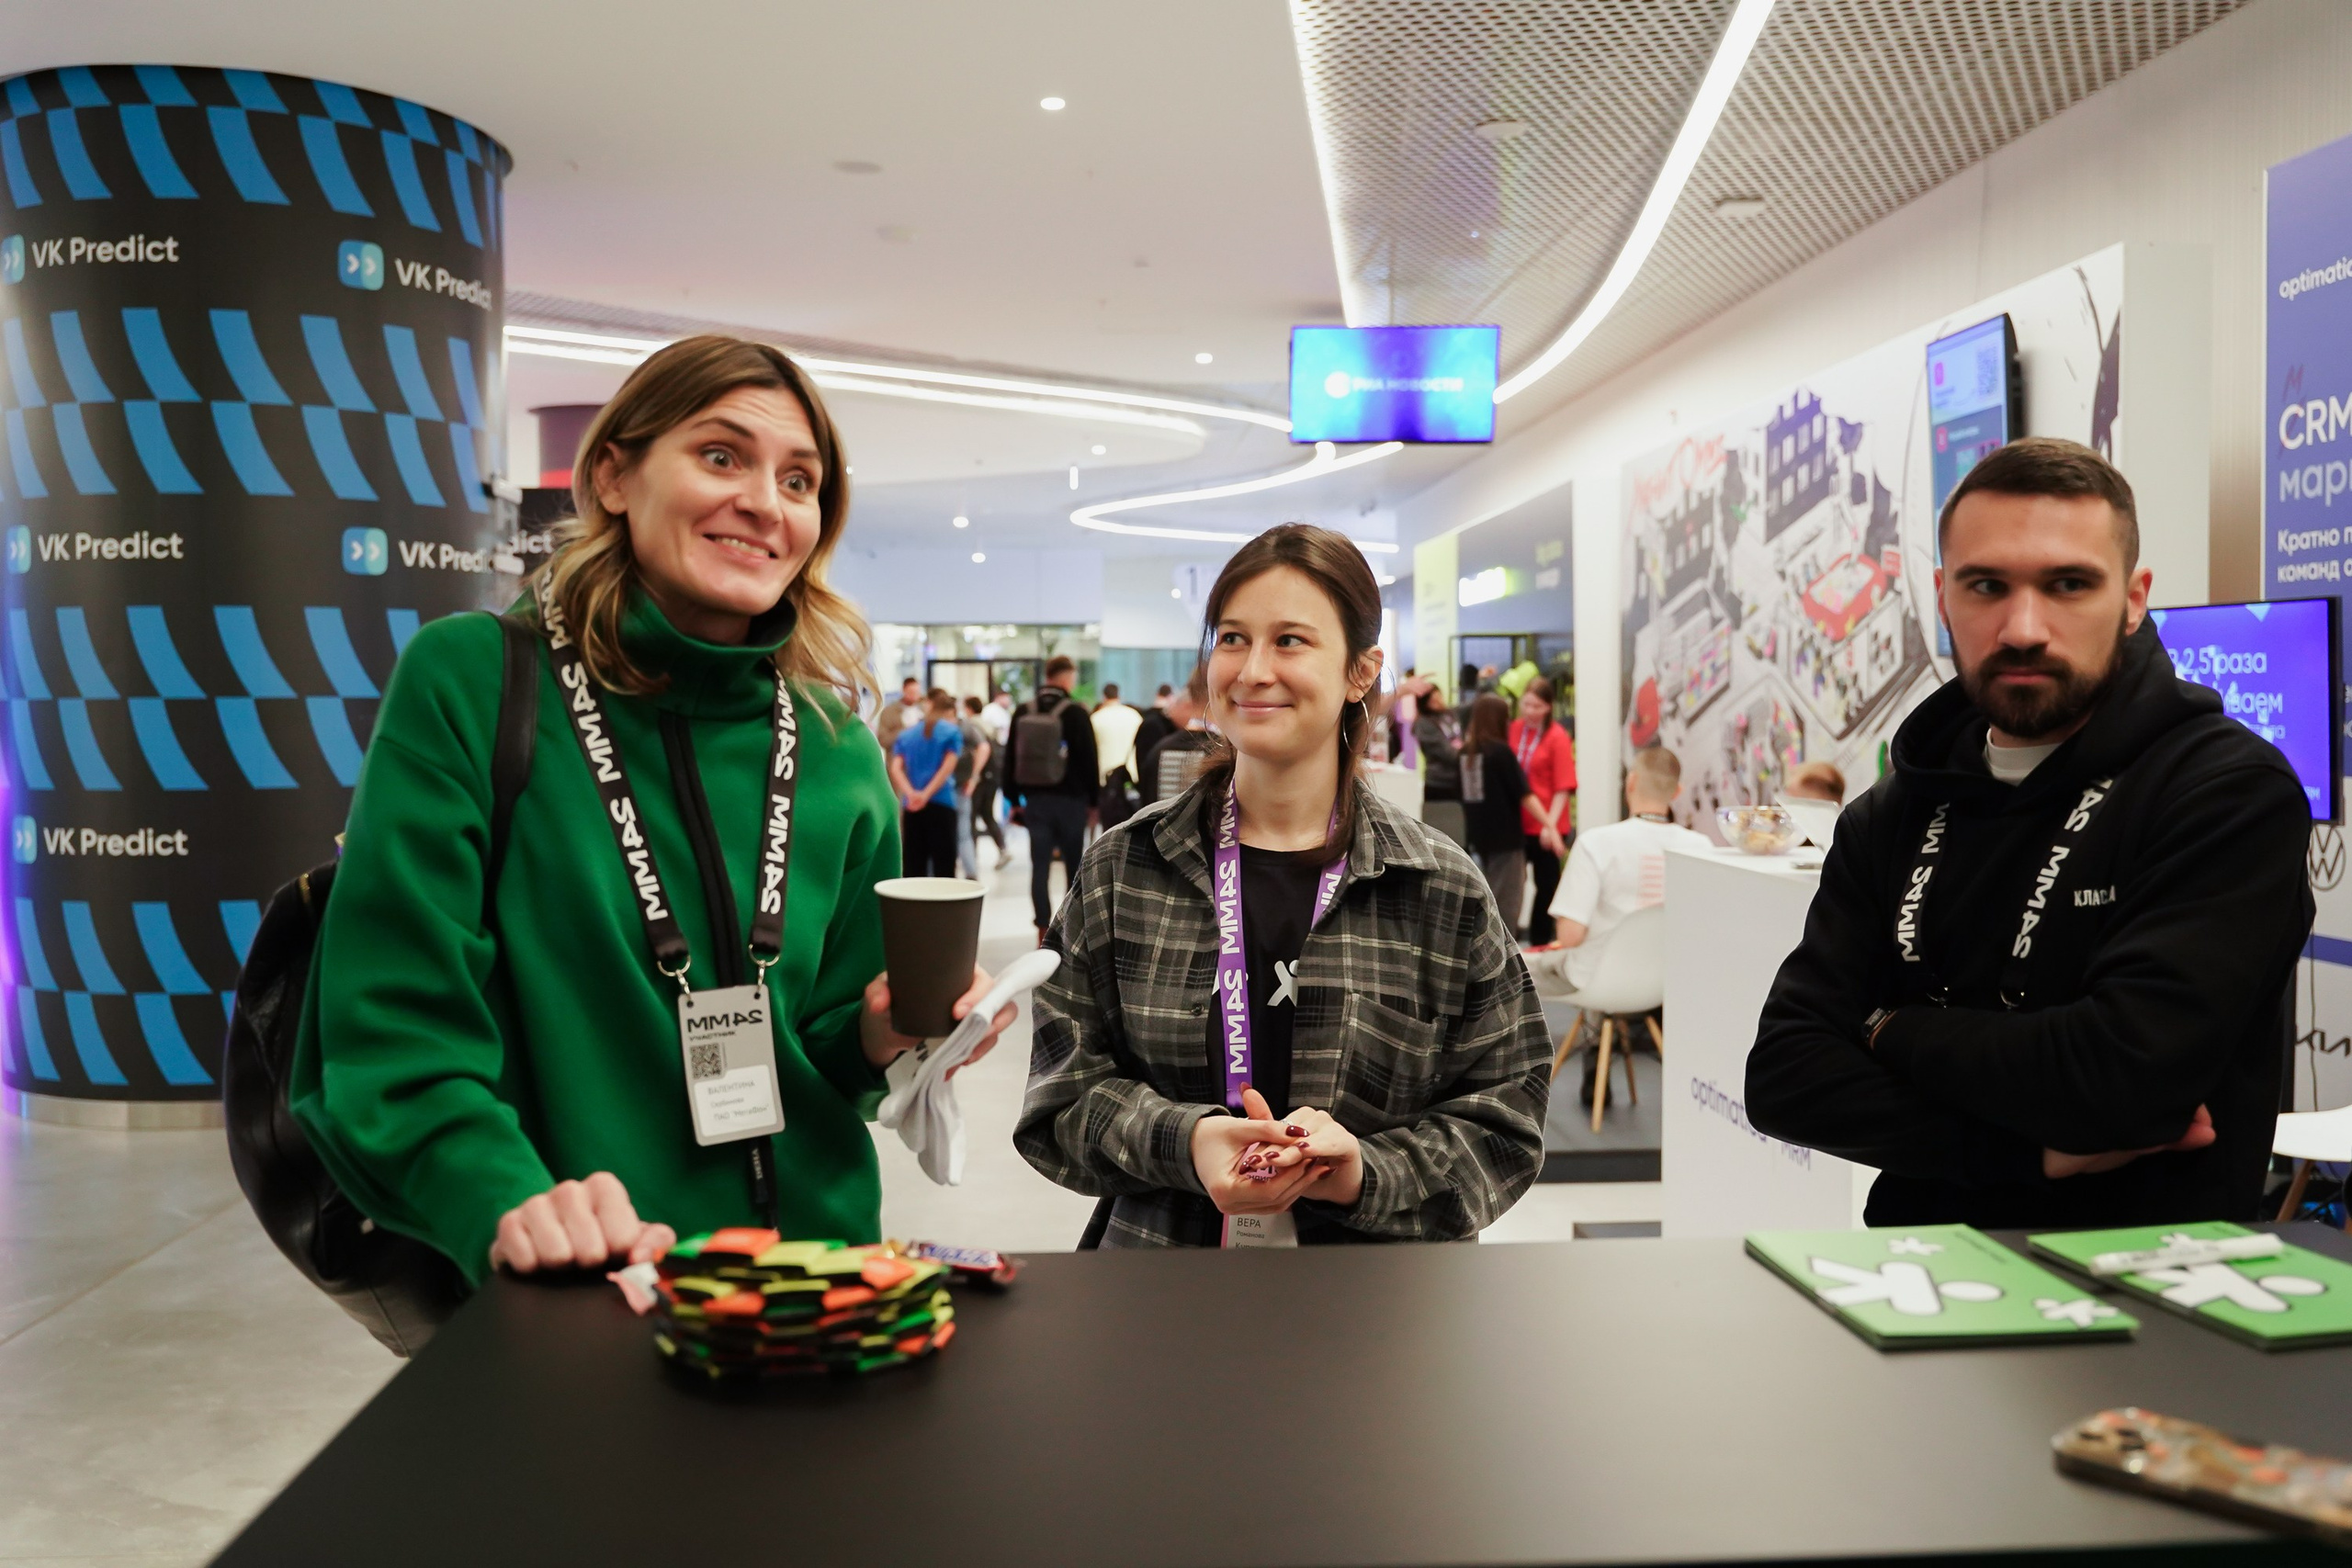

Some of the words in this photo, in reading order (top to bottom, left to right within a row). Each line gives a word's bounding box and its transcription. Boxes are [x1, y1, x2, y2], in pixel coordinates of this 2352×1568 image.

[31, 237, 65, 269] VK
[69, 233, 180, 265] Predict
[394, 257, 432, 292] VK
[38, 532, 71, 562] VK
[75, 530, 184, 560] Predict
[398, 539, 436, 570] VK
[2278, 527, 2341, 557] Кратно
[2278, 559, 2341, 583] команд
[43, 827, 76, 856] VK
[81, 827, 189, 857] Predict
[1237, 1217, 1261, 1229] ВЕРА
